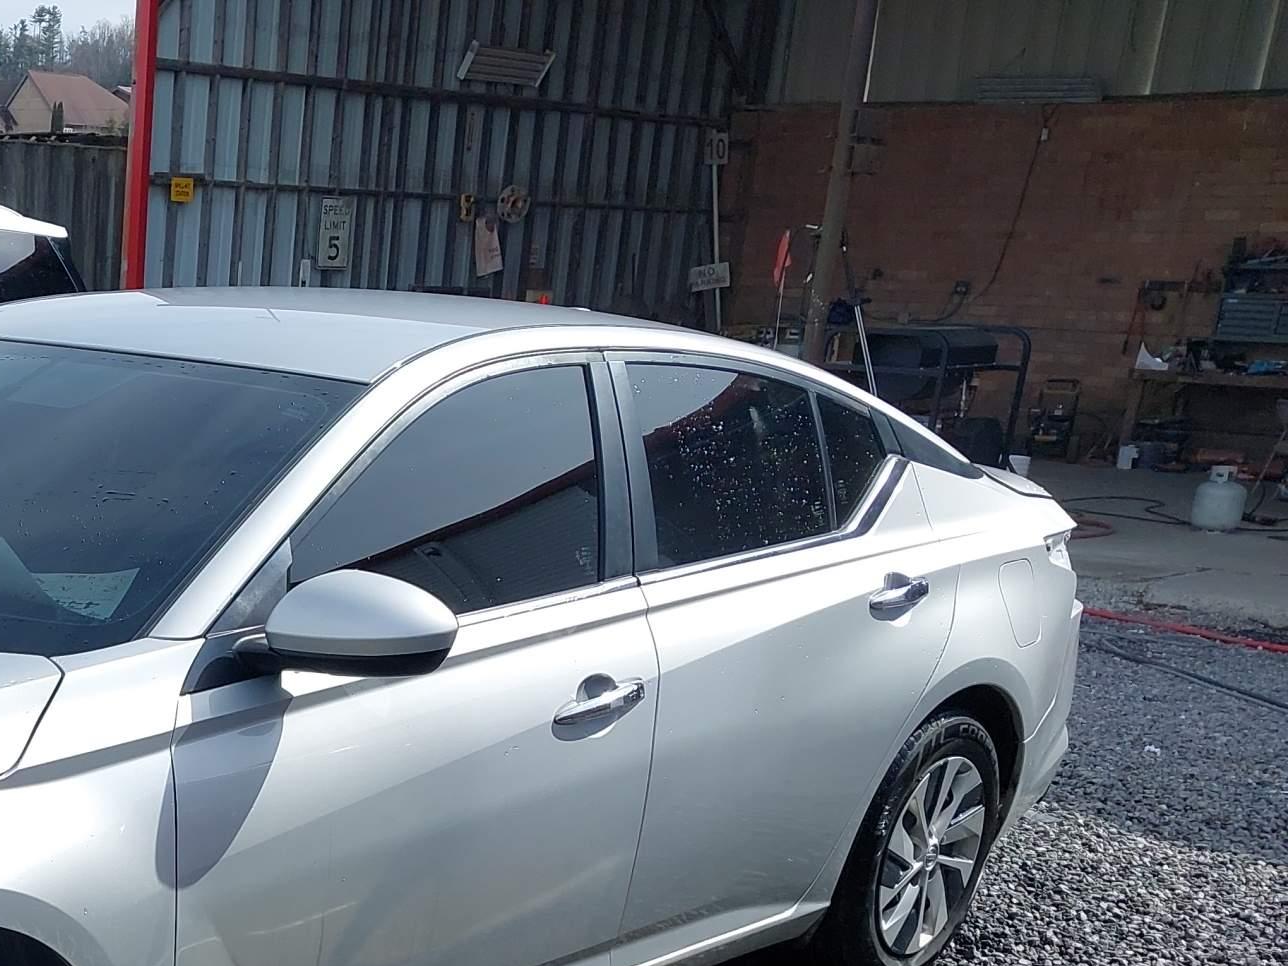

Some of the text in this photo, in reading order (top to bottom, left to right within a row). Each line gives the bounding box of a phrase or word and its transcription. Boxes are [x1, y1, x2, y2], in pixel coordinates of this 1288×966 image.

[707, 138, 725, 159] 10
[323, 204, 350, 216] SPEED
[324, 221, 346, 231] LIMIT
[327, 235, 340, 261] 5
